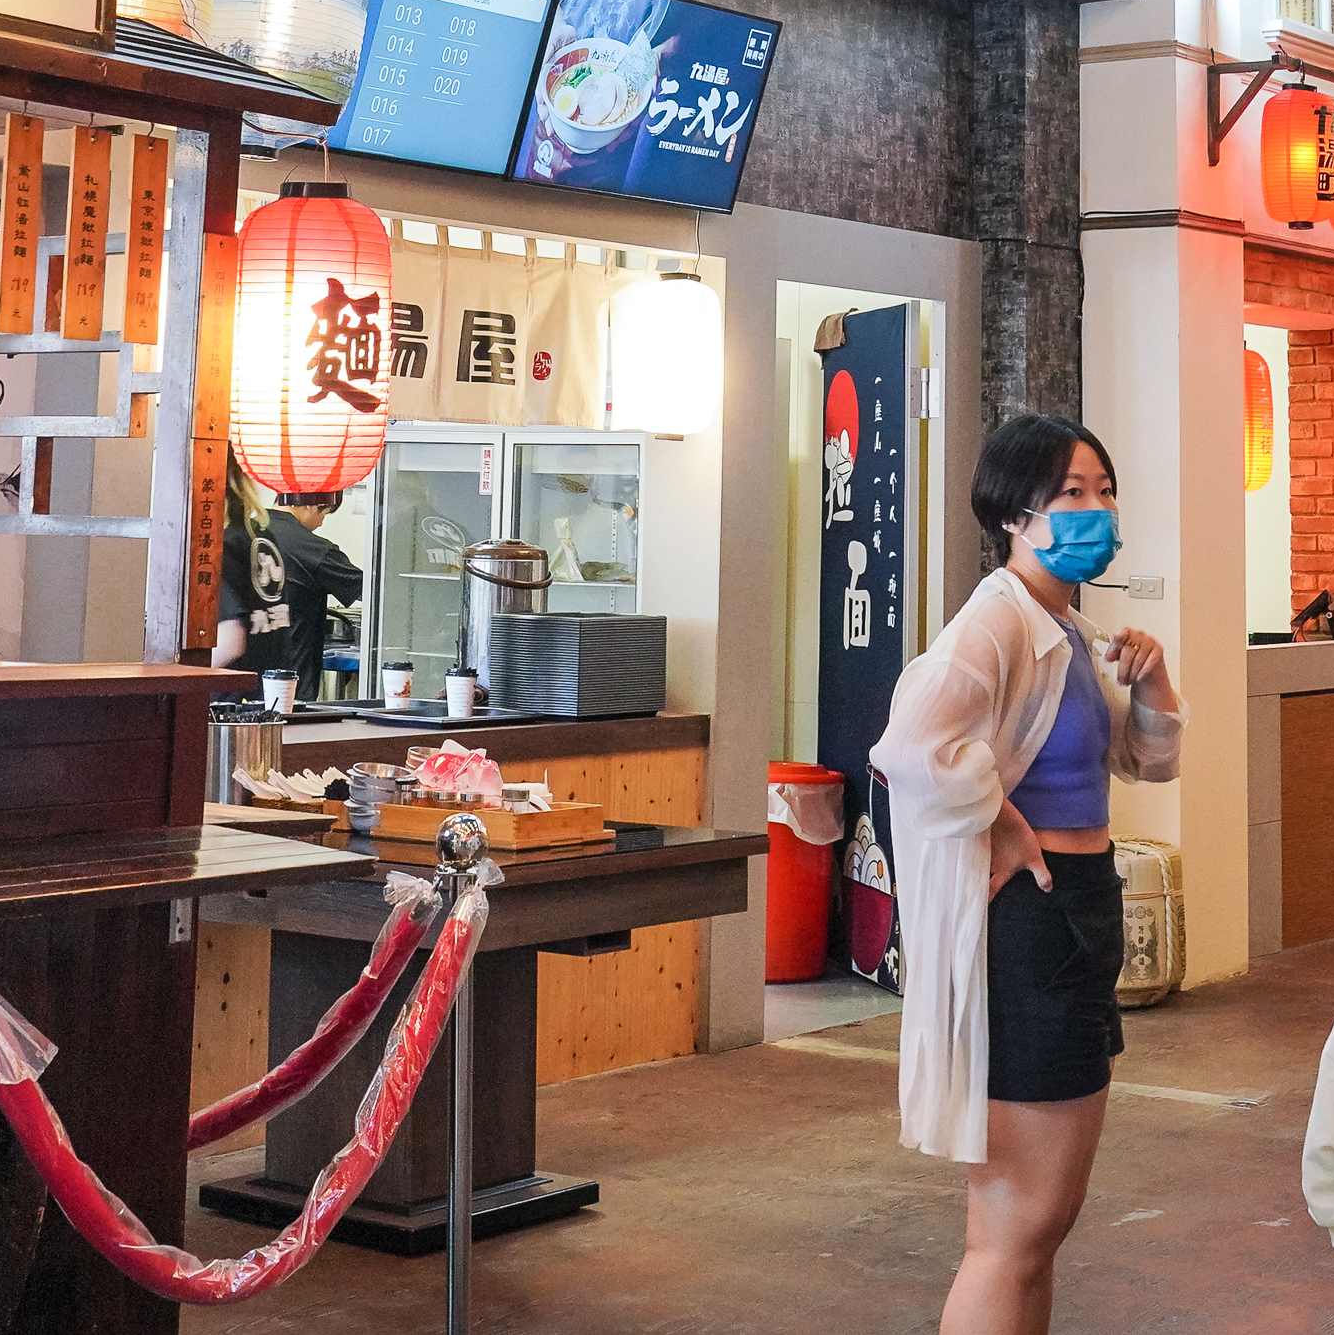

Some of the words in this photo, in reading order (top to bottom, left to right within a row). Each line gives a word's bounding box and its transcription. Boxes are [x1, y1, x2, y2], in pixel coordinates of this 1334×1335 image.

[395, 4, 422, 26] 013
[450, 16, 476, 37] 018
[387, 35, 414, 56] 014
[442, 46, 468, 66] 019
[378, 65, 407, 86] 015
[690, 62, 729, 86] 九湯屋
[434, 76, 460, 96] 020
[370, 96, 397, 116] 016
[362, 126, 391, 146] 017
[658, 140, 685, 153] EVERYDAY
[305, 277, 383, 412] 麵
